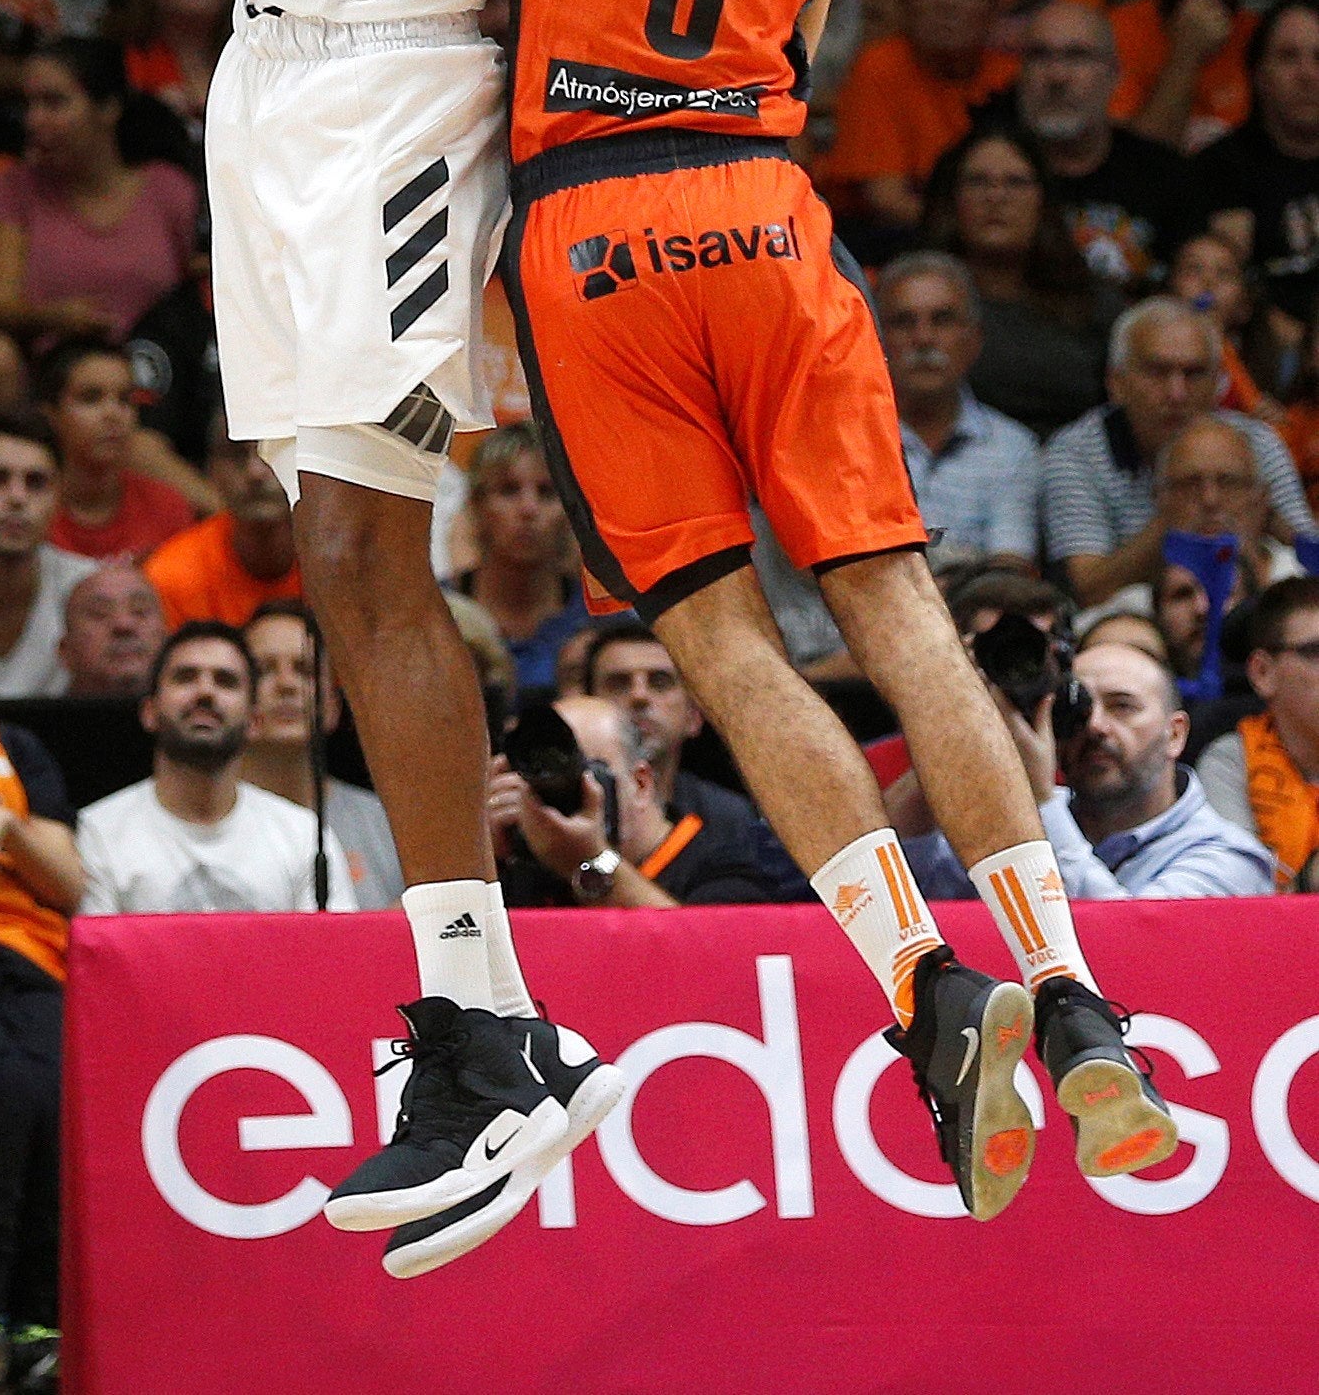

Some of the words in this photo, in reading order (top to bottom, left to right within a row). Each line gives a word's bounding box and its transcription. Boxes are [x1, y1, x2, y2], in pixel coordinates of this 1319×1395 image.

[643, 215, 802, 274] isaval
[439, 928, 482, 940] adidas
[898, 924, 930, 942] VBC
[1025, 948, 1058, 967] VBC
